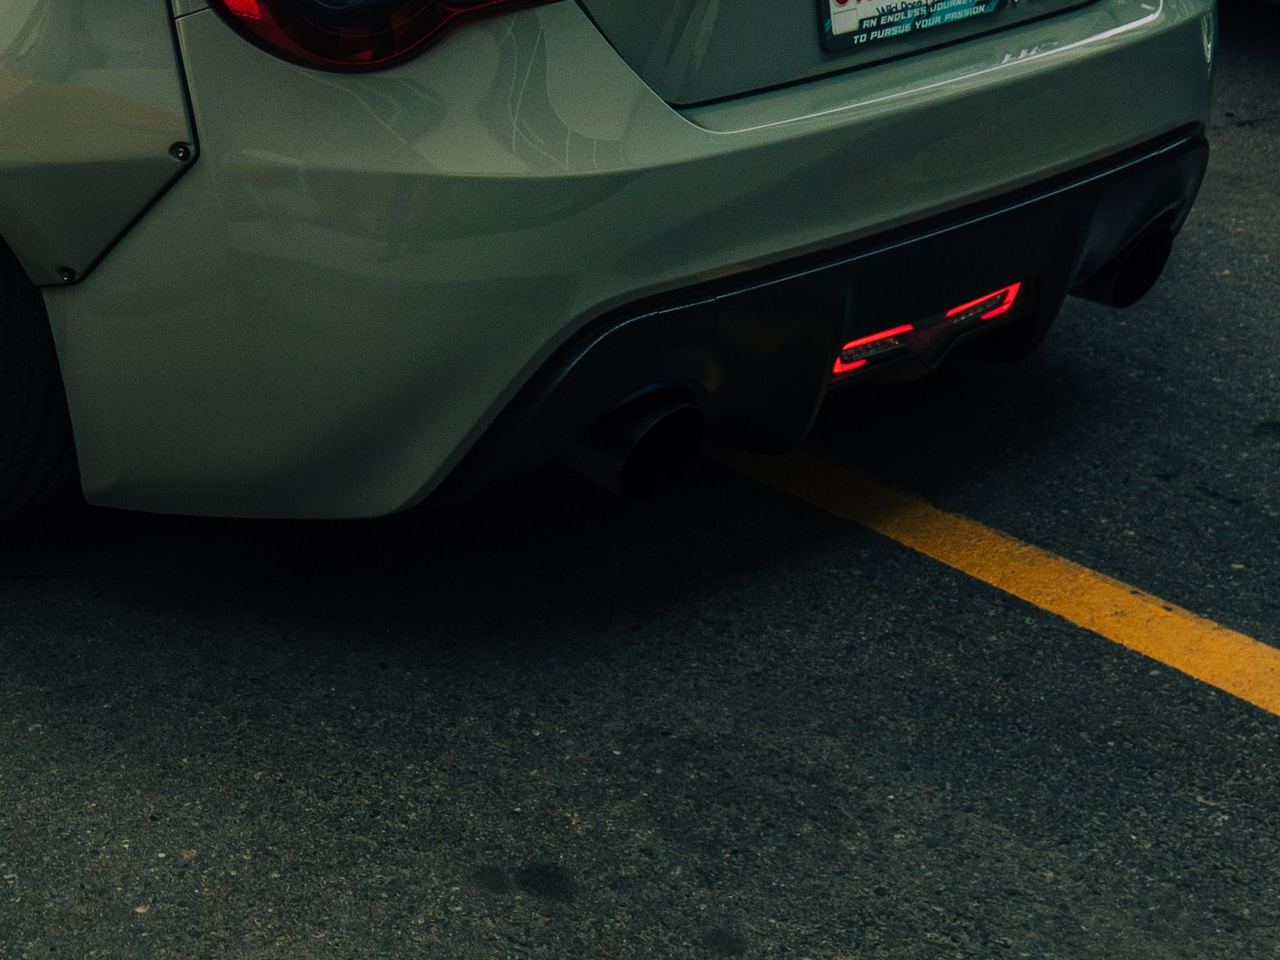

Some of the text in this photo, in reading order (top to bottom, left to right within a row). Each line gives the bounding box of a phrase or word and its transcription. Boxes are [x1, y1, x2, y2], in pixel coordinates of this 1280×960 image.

[852, 3, 987, 45] TO PURSUE YOUR PASSION
[862, 17, 879, 29] AN
[880, 5, 928, 26] ENDLESS
